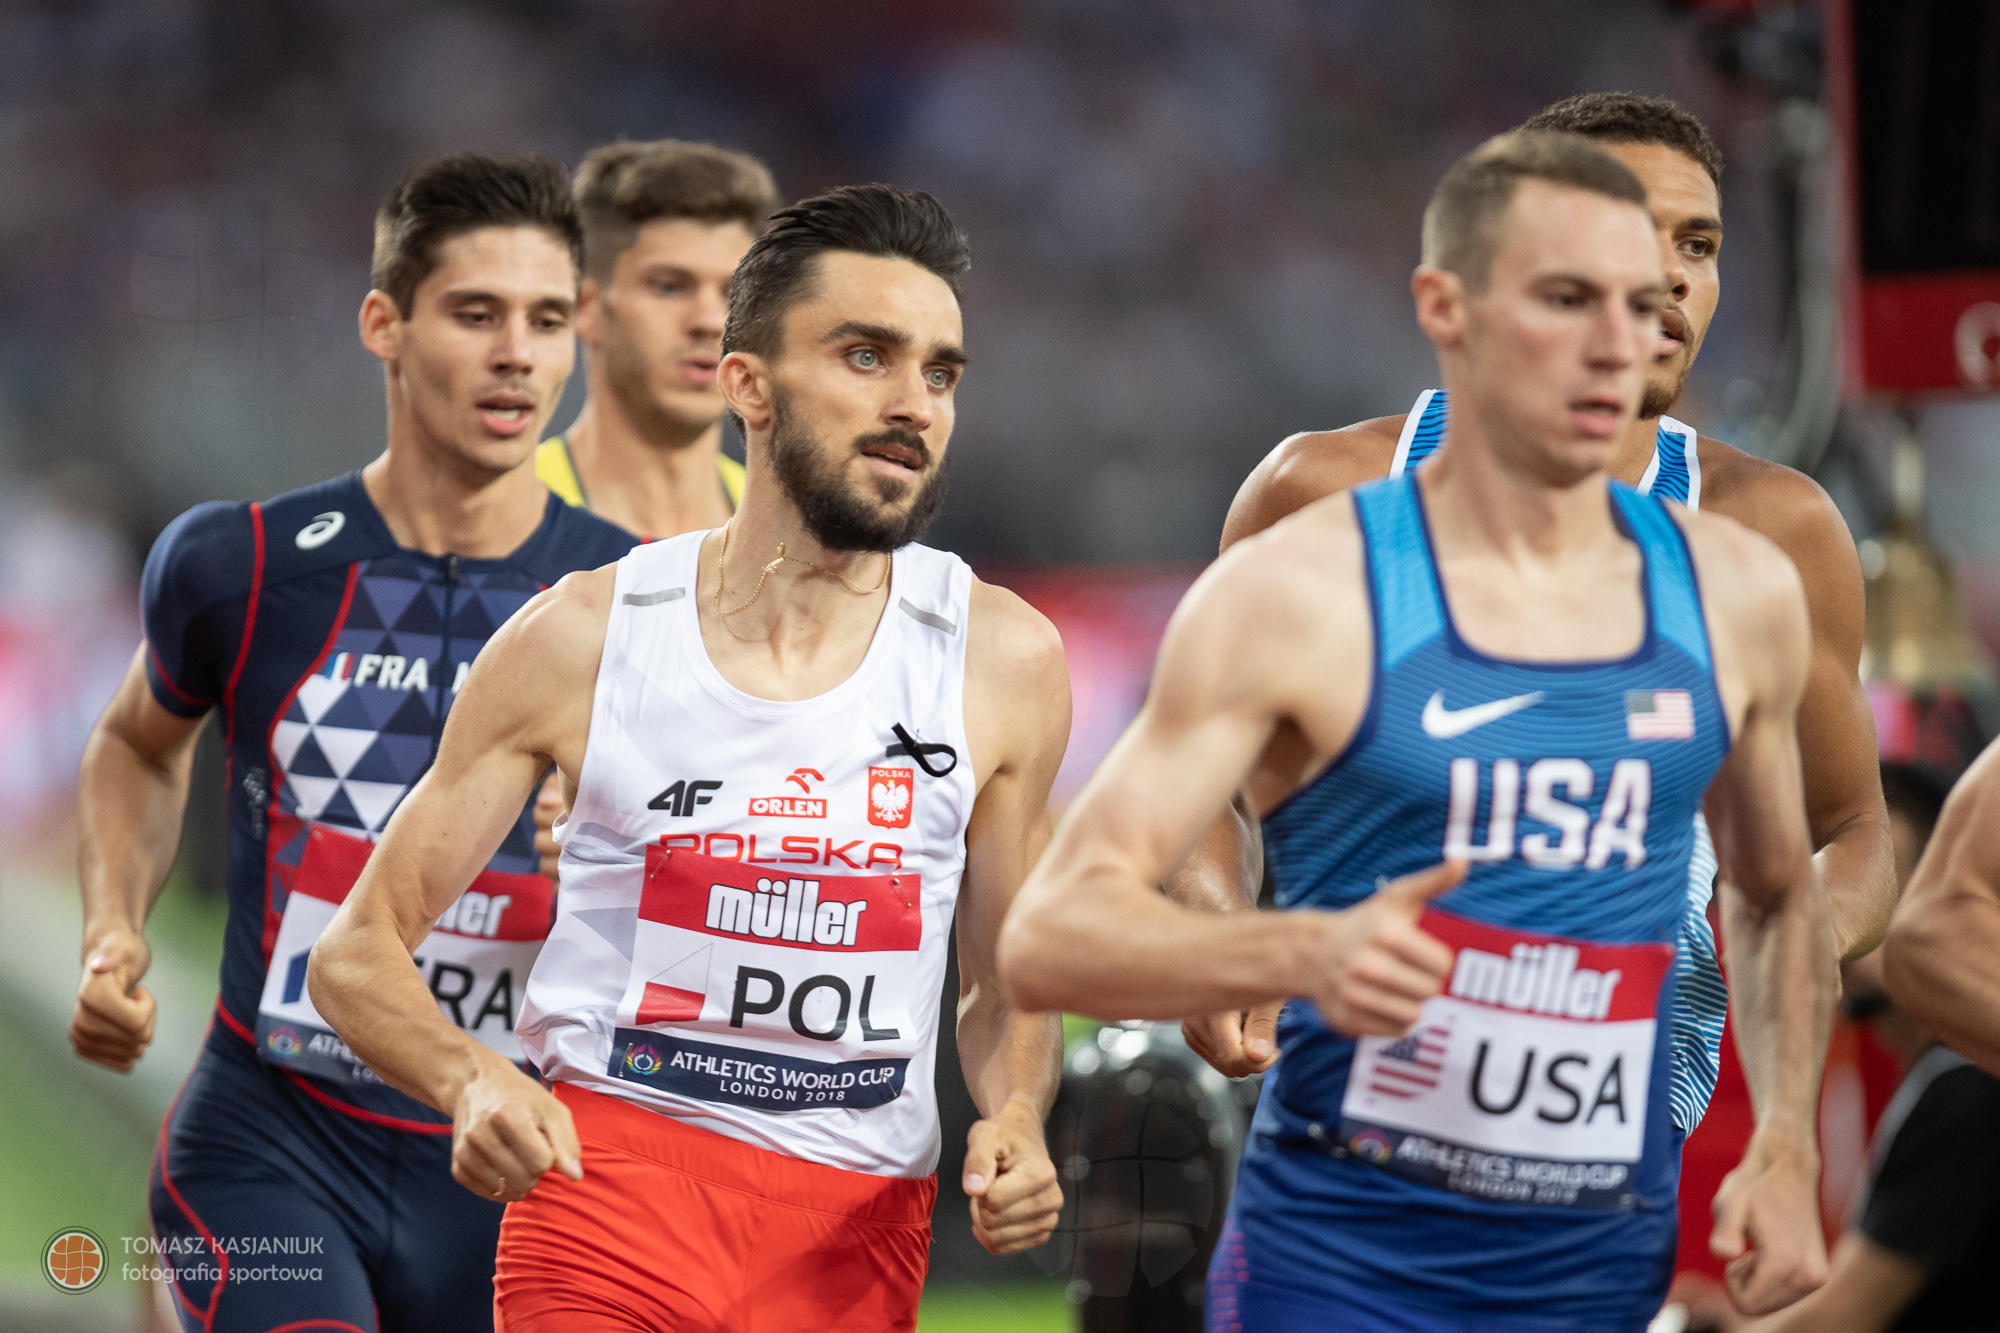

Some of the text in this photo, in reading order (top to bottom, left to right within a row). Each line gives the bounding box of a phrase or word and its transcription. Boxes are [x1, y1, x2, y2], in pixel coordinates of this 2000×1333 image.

[354, 653, 428, 692] FRA
[647, 780, 723, 817] 4F
[871, 769, 911, 778] POLSKA
[752, 799, 823, 816] ORLEN
[1444, 758, 1651, 870] USA
[705, 877, 867, 946] müller
[413, 955, 514, 1031] RA
[729, 965, 900, 1042] POL
[1451, 943, 1621, 1019] müller
[670, 1051, 895, 1089] ATHLETICS WORLD CUP
[720, 1080, 845, 1102] LONDON 2018
[1470, 1039, 1626, 1127] USA
